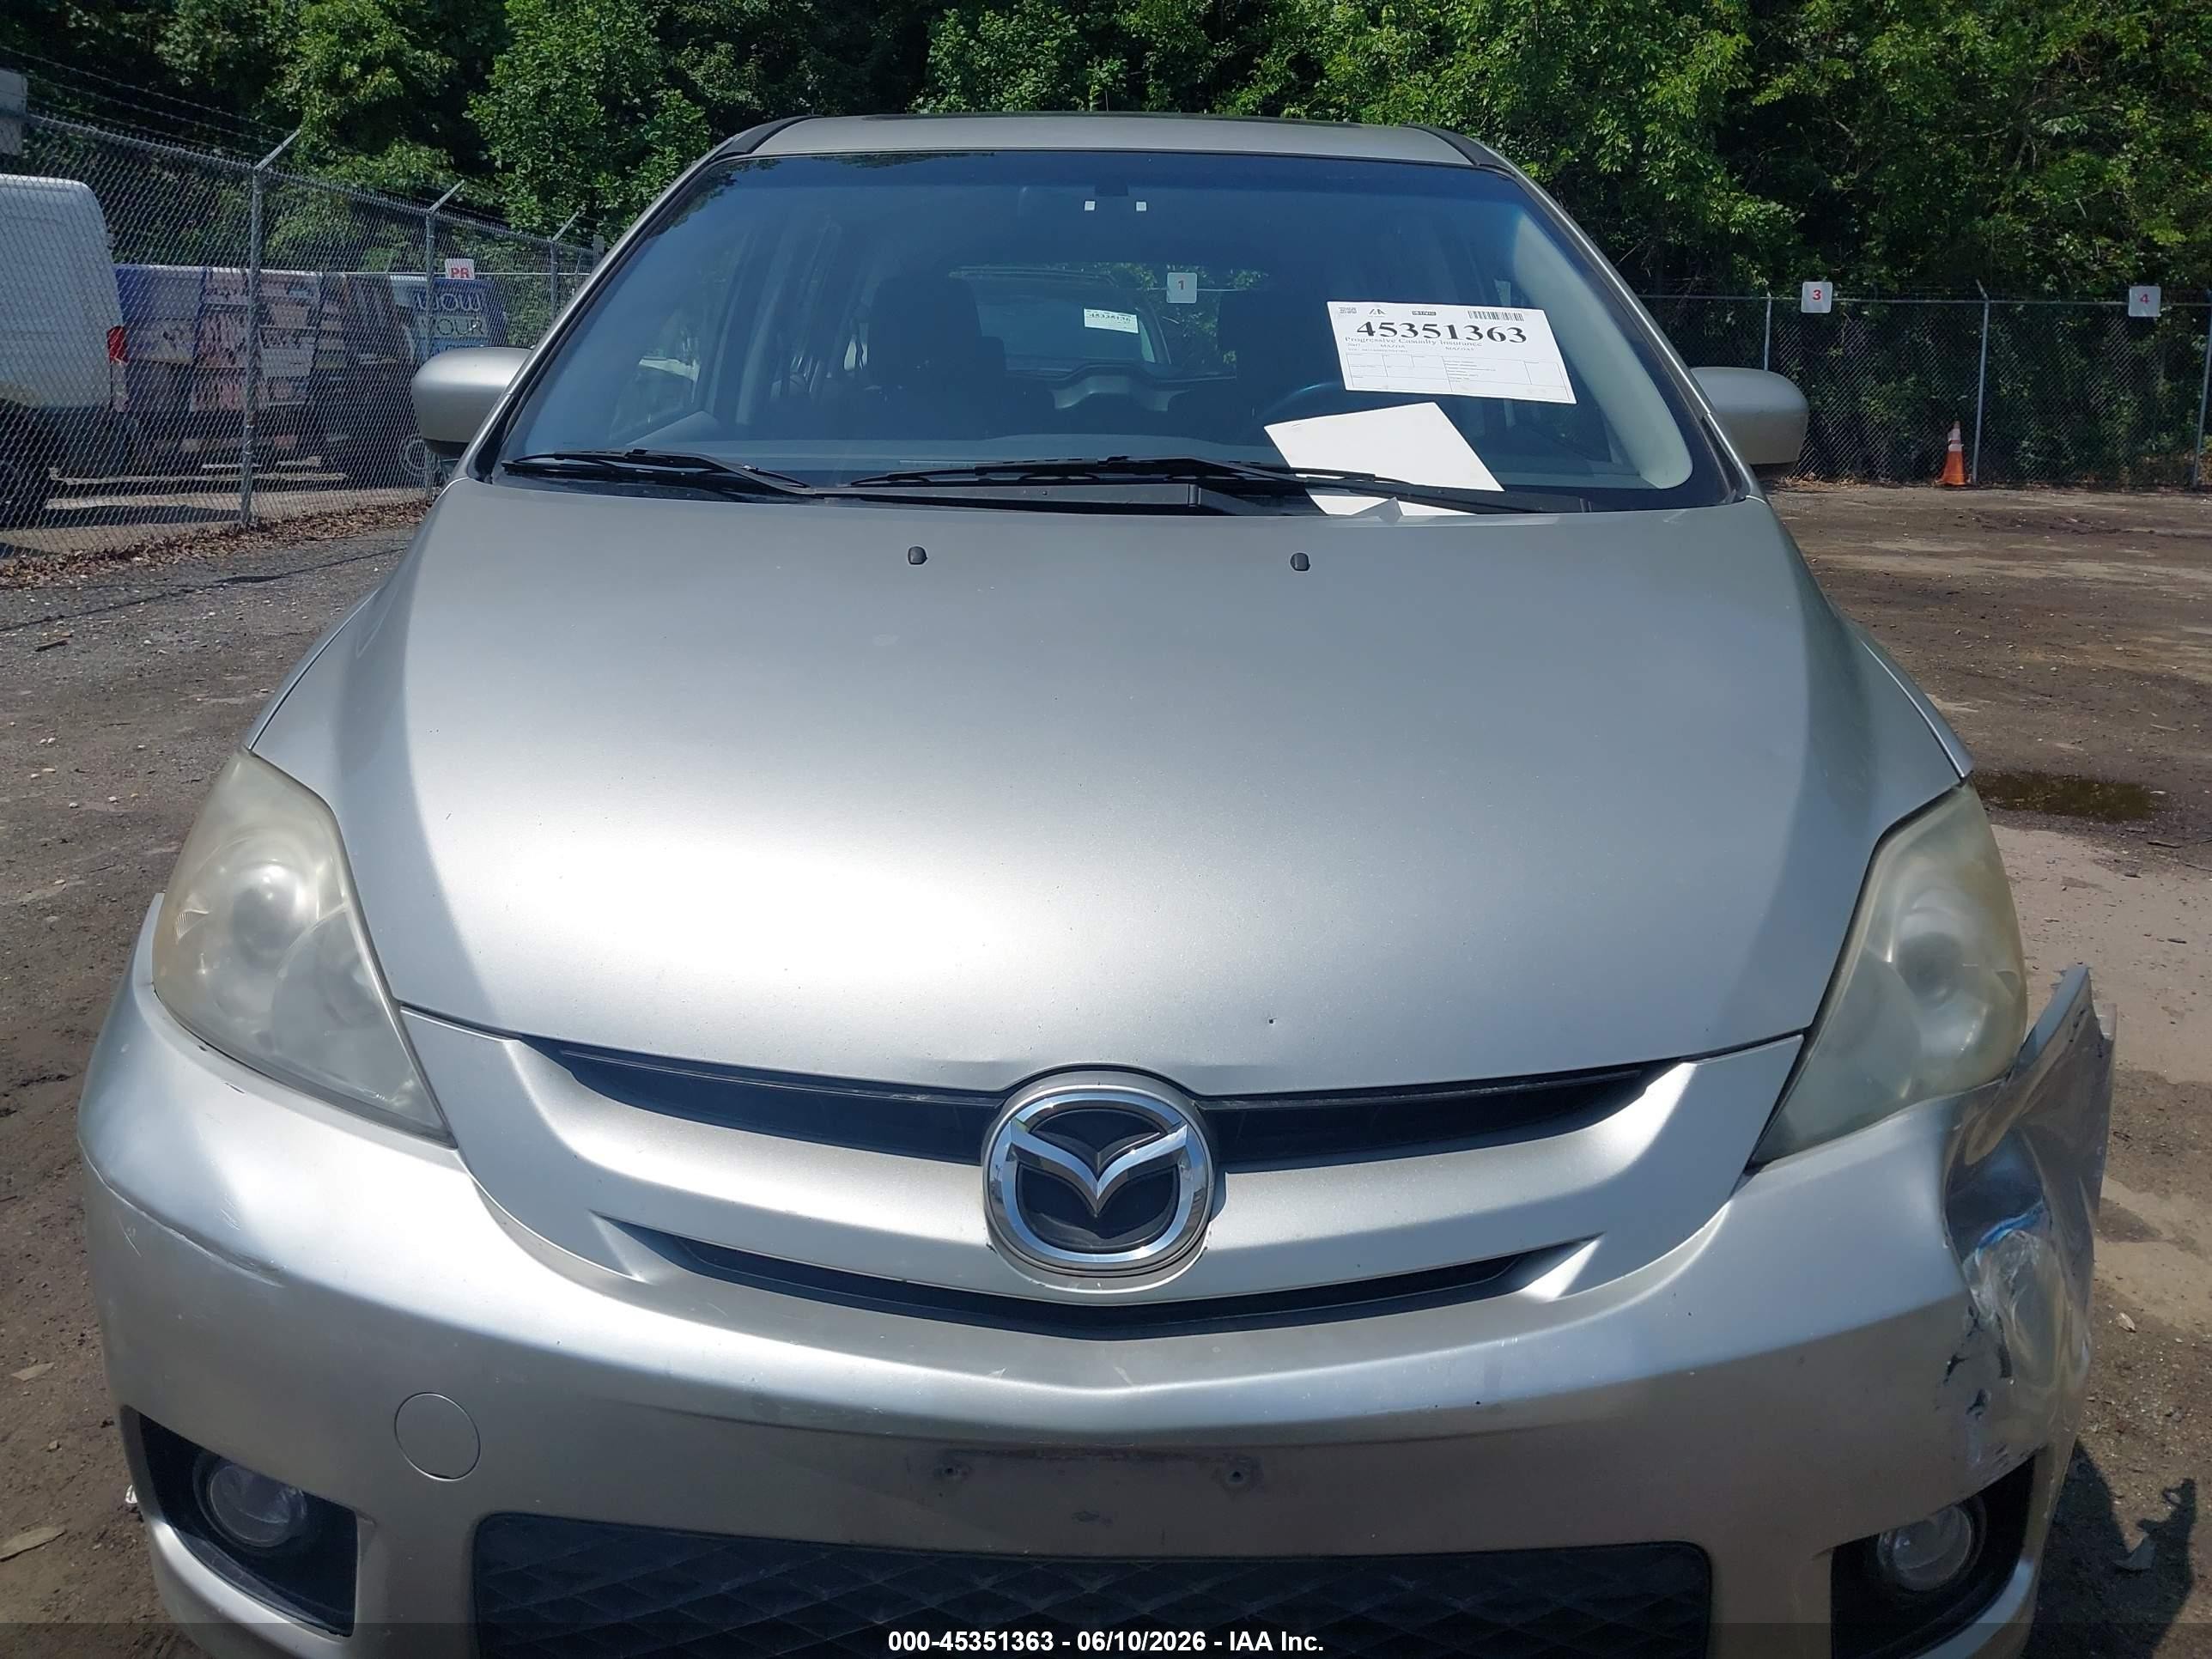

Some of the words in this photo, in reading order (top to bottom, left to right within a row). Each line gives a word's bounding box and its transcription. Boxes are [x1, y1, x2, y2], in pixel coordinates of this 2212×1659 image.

[450, 267, 471, 278] PR
[1177, 280, 1185, 290] 1
[1813, 289, 1821, 301] 3
[2140, 294, 2150, 304] 4
[1356, 321, 1527, 343] 45351363
